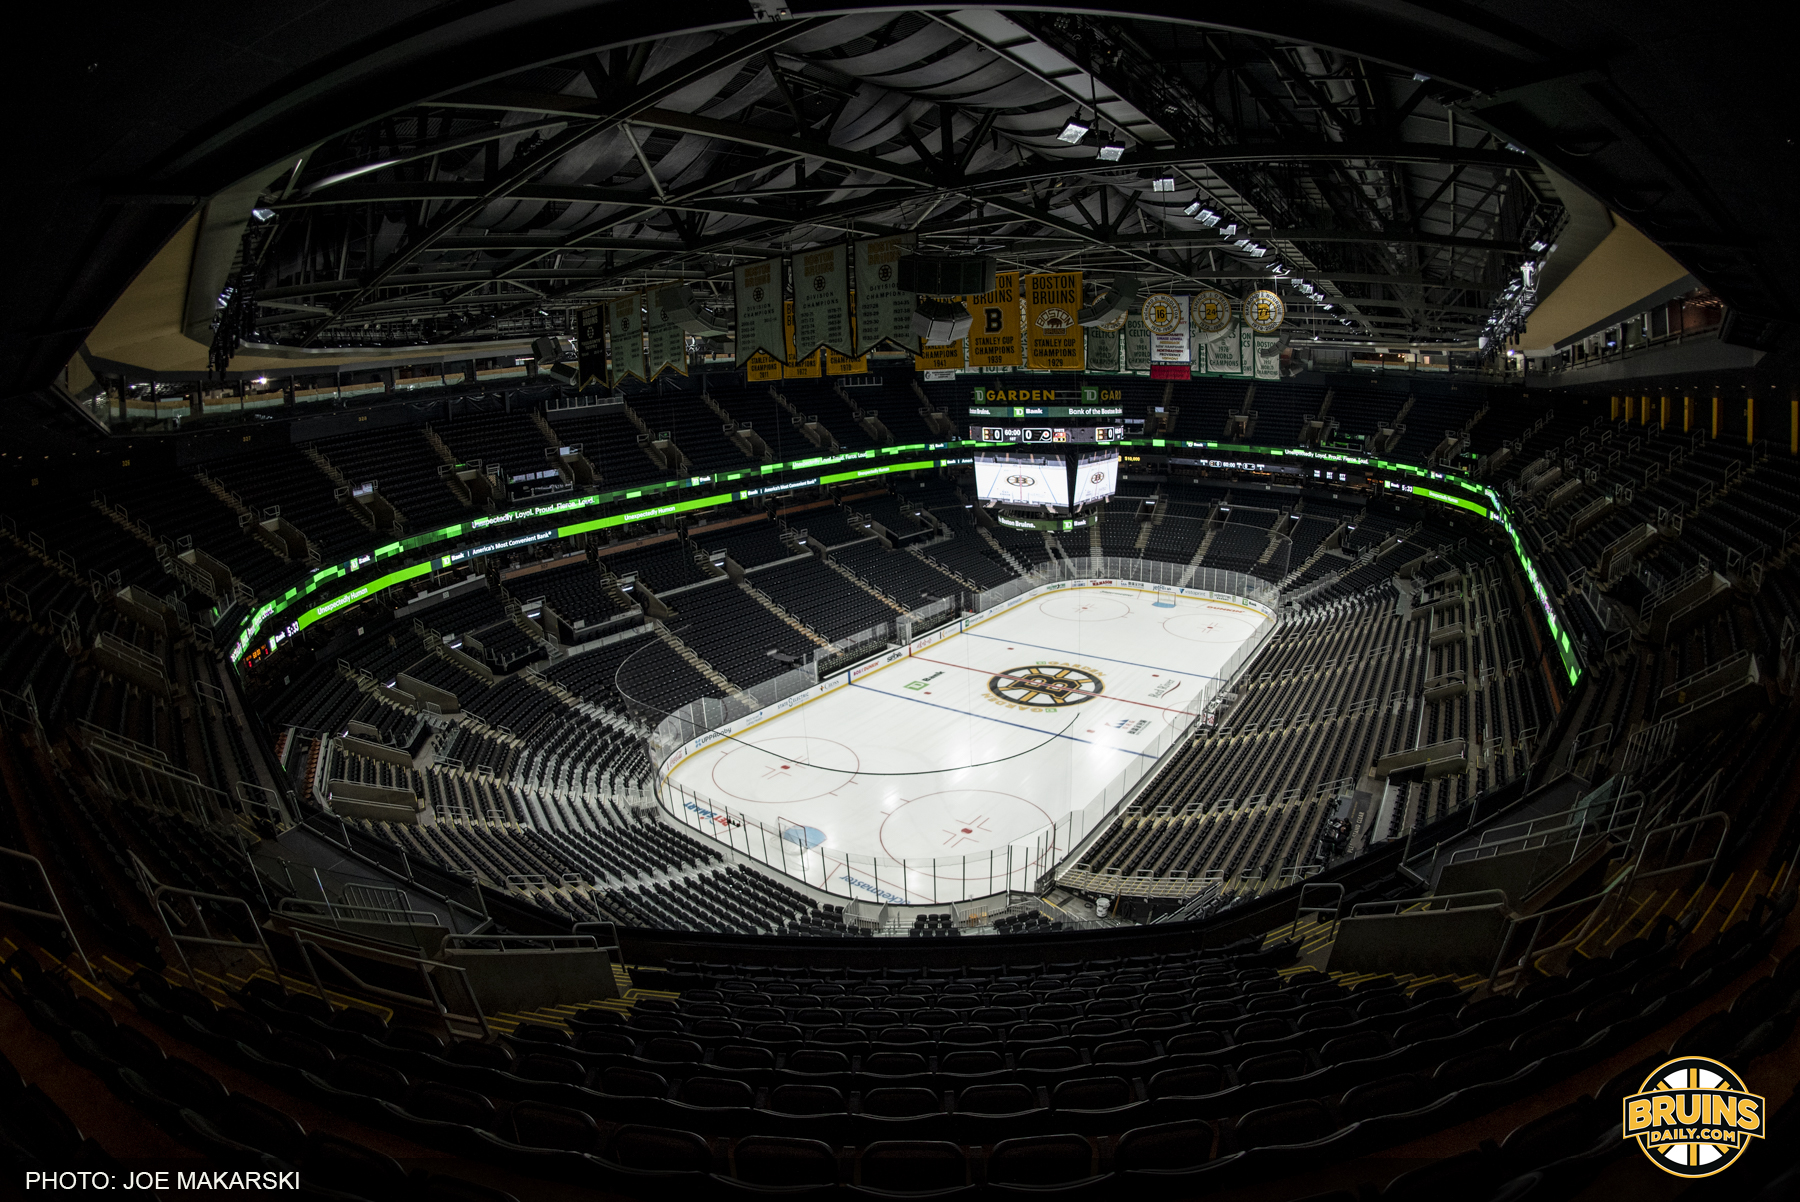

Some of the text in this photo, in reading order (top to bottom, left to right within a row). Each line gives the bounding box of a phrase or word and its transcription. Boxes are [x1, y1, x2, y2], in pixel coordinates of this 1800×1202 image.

[1032, 275, 1075, 290] BOSTON
[973, 290, 1013, 305] BRUINS
[1033, 289, 1075, 305] BRUINS
[1036, 308, 1074, 328] BOSTON
[1156, 309, 1165, 319] 16
[985, 307, 1002, 333] B
[1128, 320, 1144, 329] BOST
[975, 336, 1014, 346] STANLEY CUP
[1034, 338, 1076, 348] STANLEY CUP
[922, 349, 958, 359] CHAMPIONS
[975, 346, 1015, 356] CHAMPIONS
[1033, 348, 1077, 358] CHAMPIONS
[987, 355, 1002, 364] 1939
[1048, 358, 1064, 367] 1929
[1209, 359, 1239, 367] CHAMPIONS
[986, 389, 1055, 401] GARDEN
[994, 429, 1001, 440] 0
[1025, 429, 1033, 440] 0
[471, 496, 596, 530] Unexpectedly Loyal. Proud. Fierce. Loud.
[624, 506, 676, 521] Unexpectedly Human
[451, 552, 465, 561] Bank
[472, 543, 495, 556] America's
[494, 541, 509, 550] Most
[508, 534, 537, 548] Convenient
[317, 587, 369, 616] Unexpectedly Human
[921, 671, 946, 682] Bank
[1356, 811, 1366, 824] CLEAR
